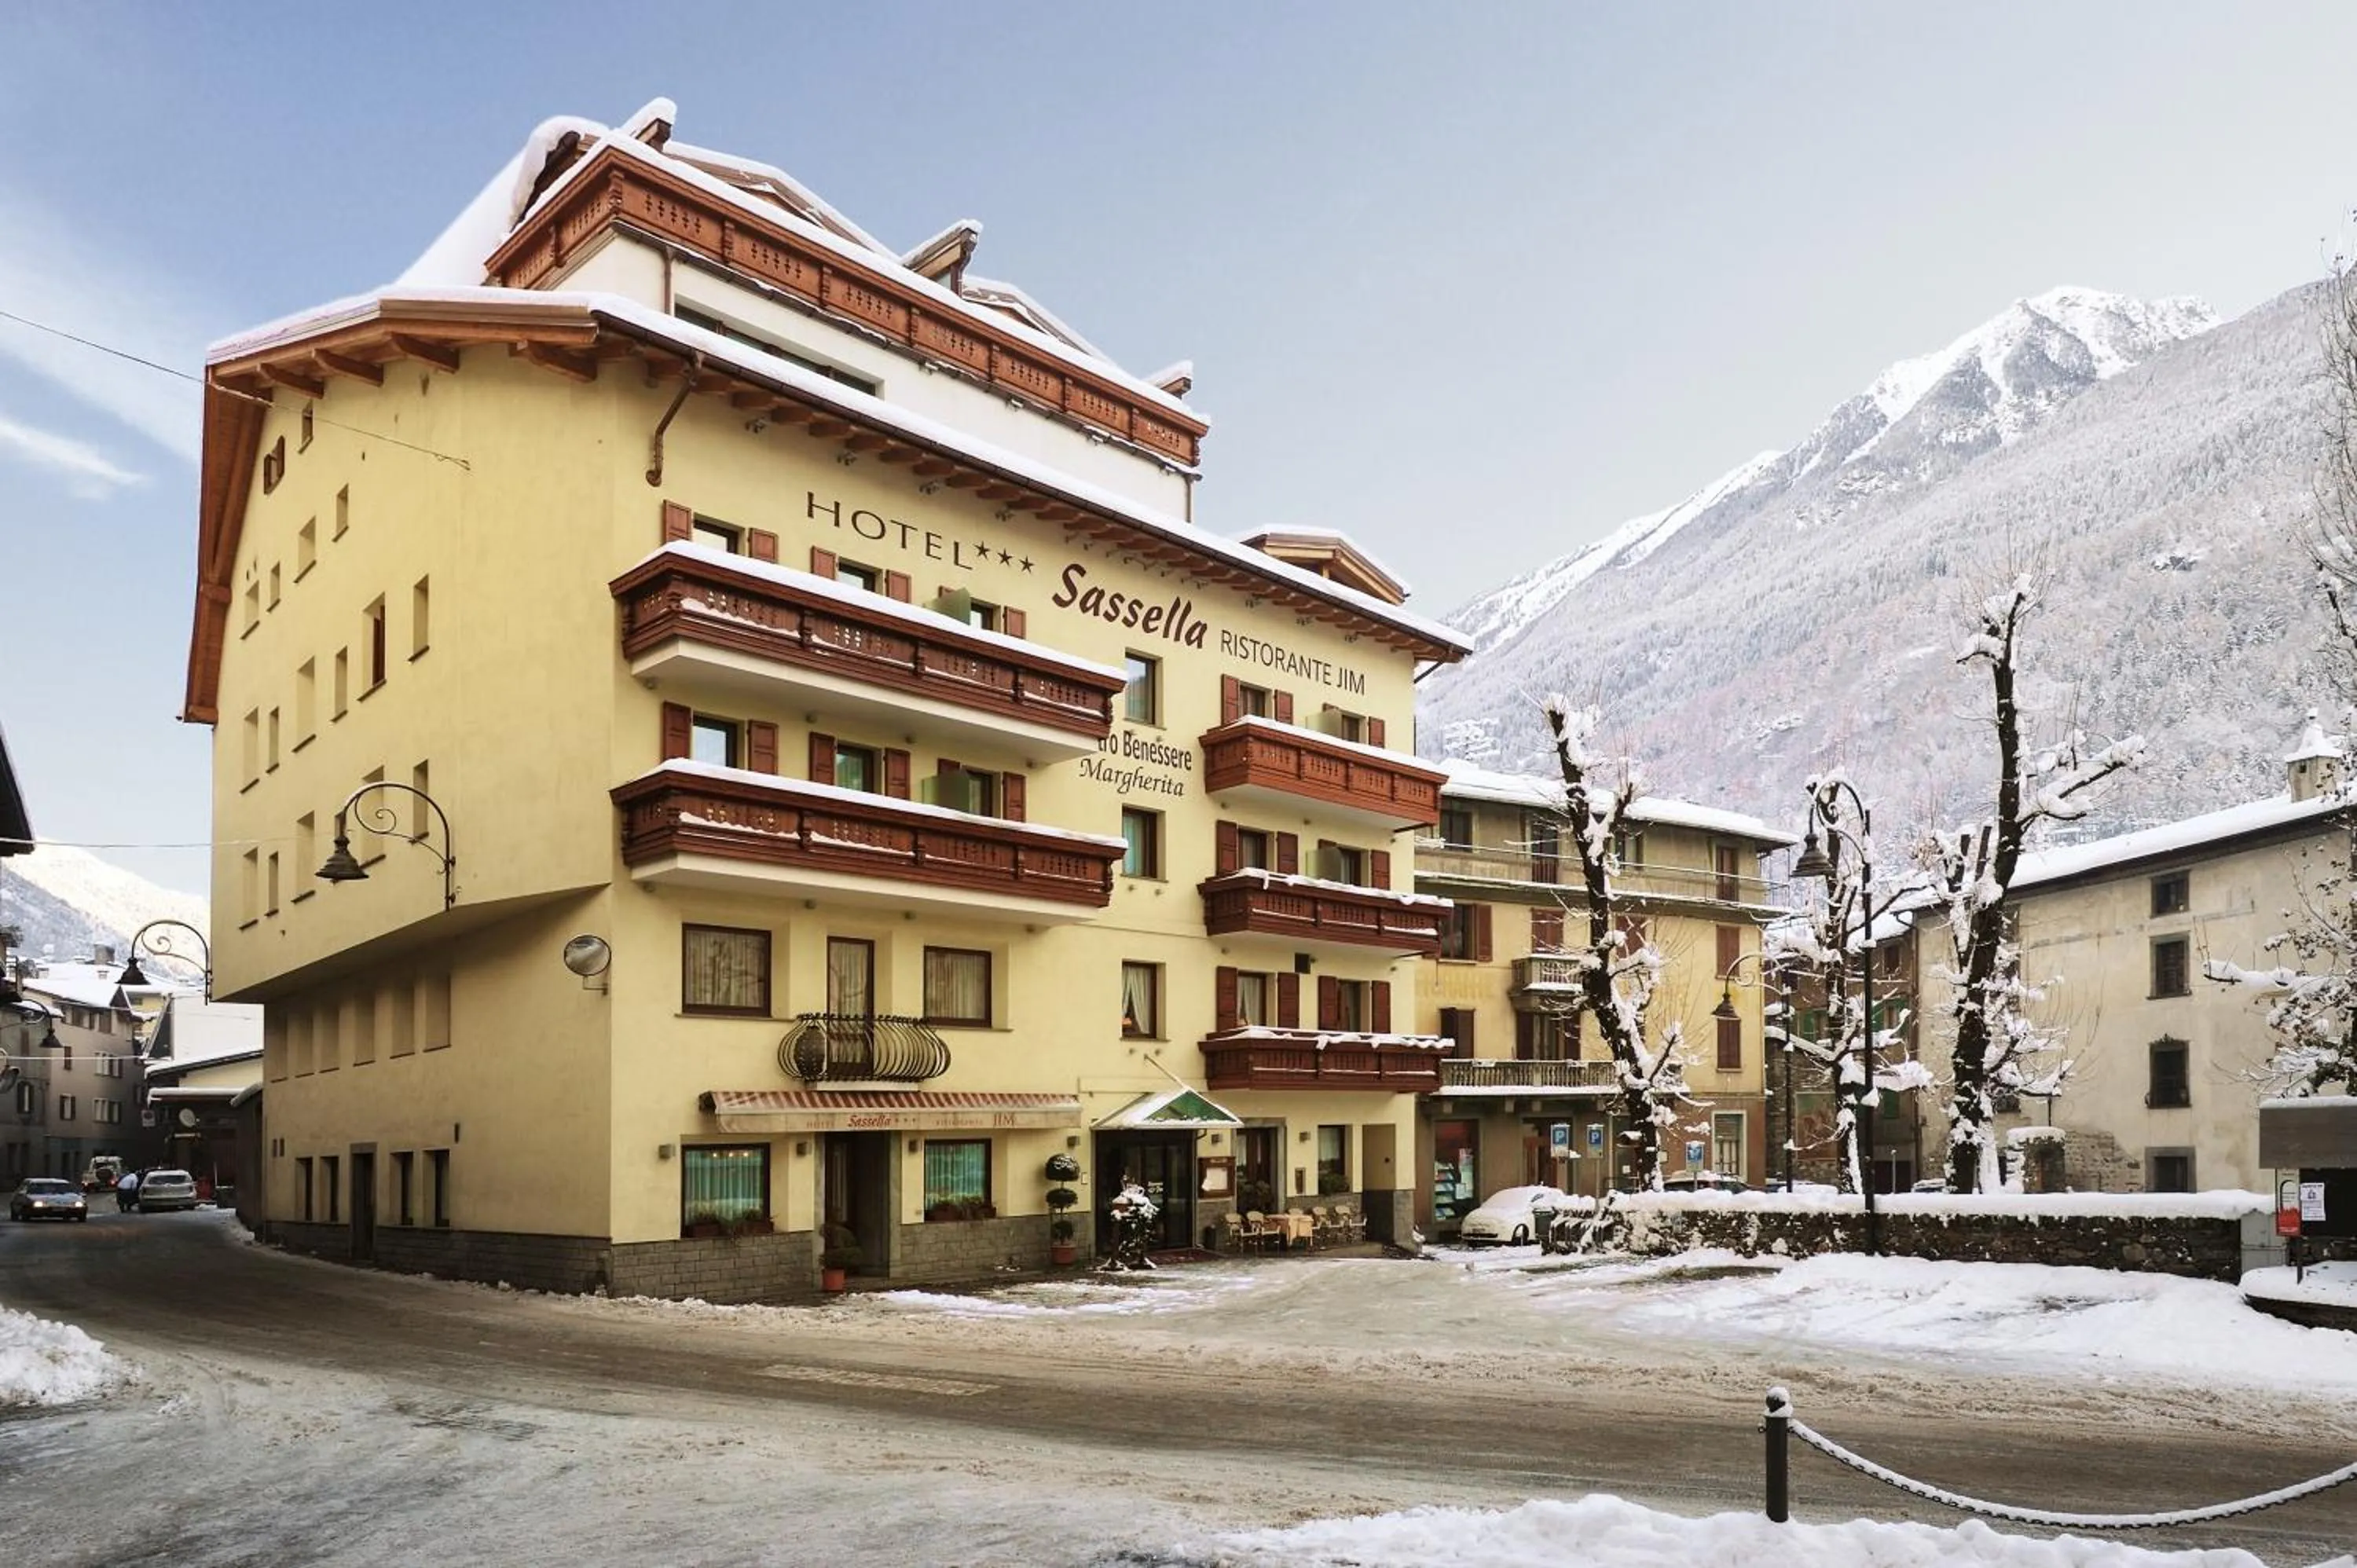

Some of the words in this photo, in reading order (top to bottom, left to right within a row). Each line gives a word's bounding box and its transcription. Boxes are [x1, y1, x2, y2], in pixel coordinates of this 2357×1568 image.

[807, 491, 973, 570] HOTEL
[1051, 562, 1208, 650] Sassella
[1220, 629, 1332, 686] RISTORANTE
[1336, 666, 1365, 696] JIM
[1123, 730, 1192, 771] Benessere
[1079, 758, 1185, 797] Margherita
[847, 1114, 892, 1128] Sassella
[993, 1112, 1015, 1127] JIM
[1556, 1130, 1564, 1142] P
[1591, 1131, 1599, 1143] P
